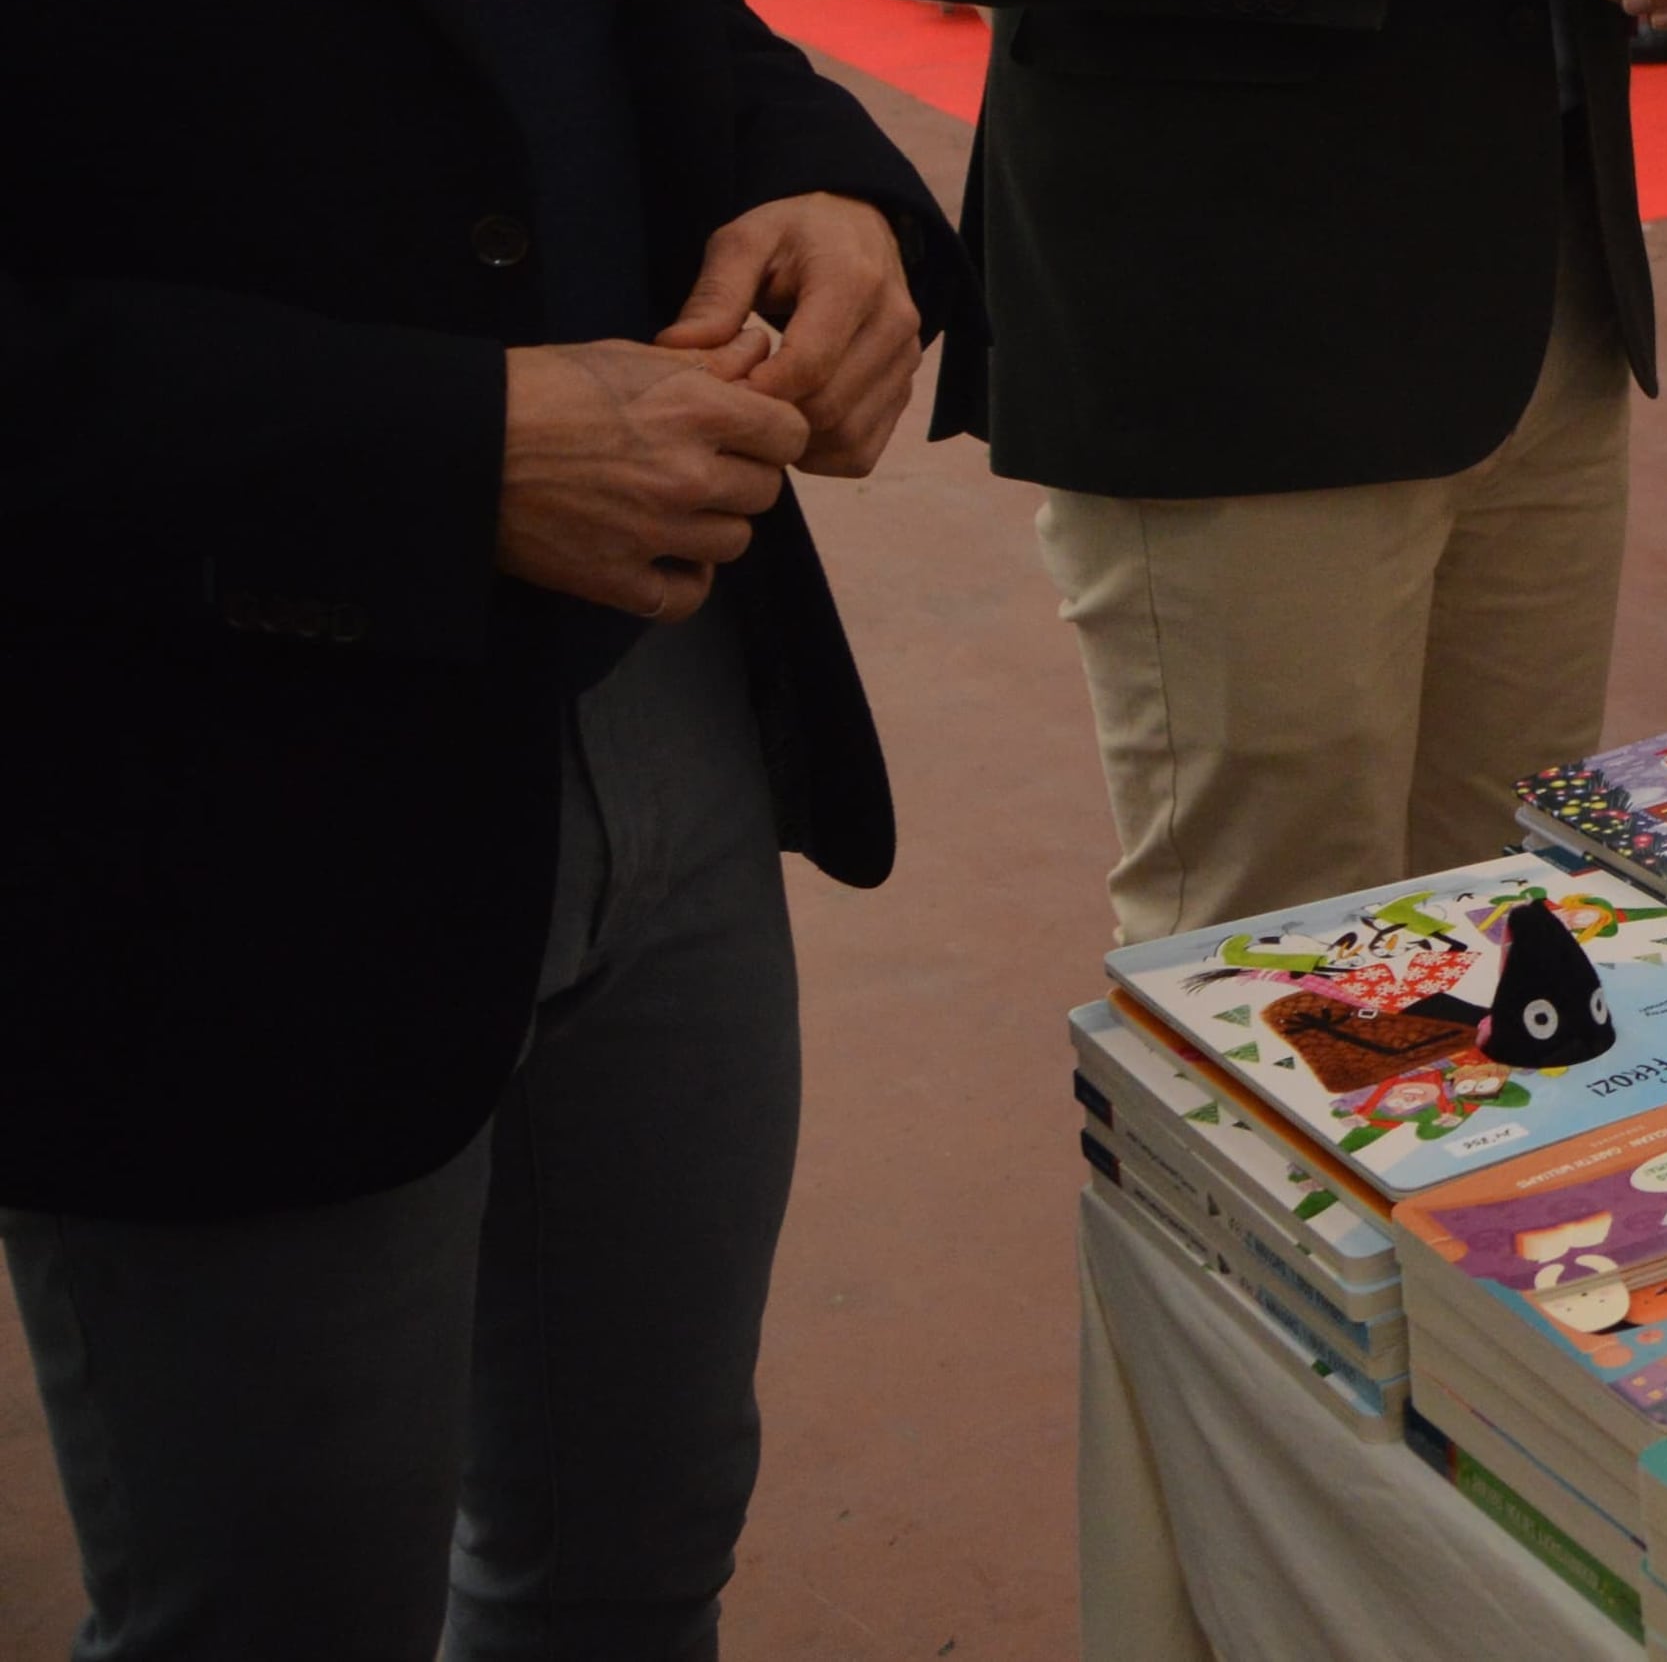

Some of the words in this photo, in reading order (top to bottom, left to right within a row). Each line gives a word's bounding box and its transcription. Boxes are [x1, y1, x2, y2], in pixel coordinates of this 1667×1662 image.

[1584, 1056, 1667, 1098] FEROZ!
[1568, 1143, 1622, 1171] GARETH
[1515, 1160, 1576, 1190] WILLIAMS
